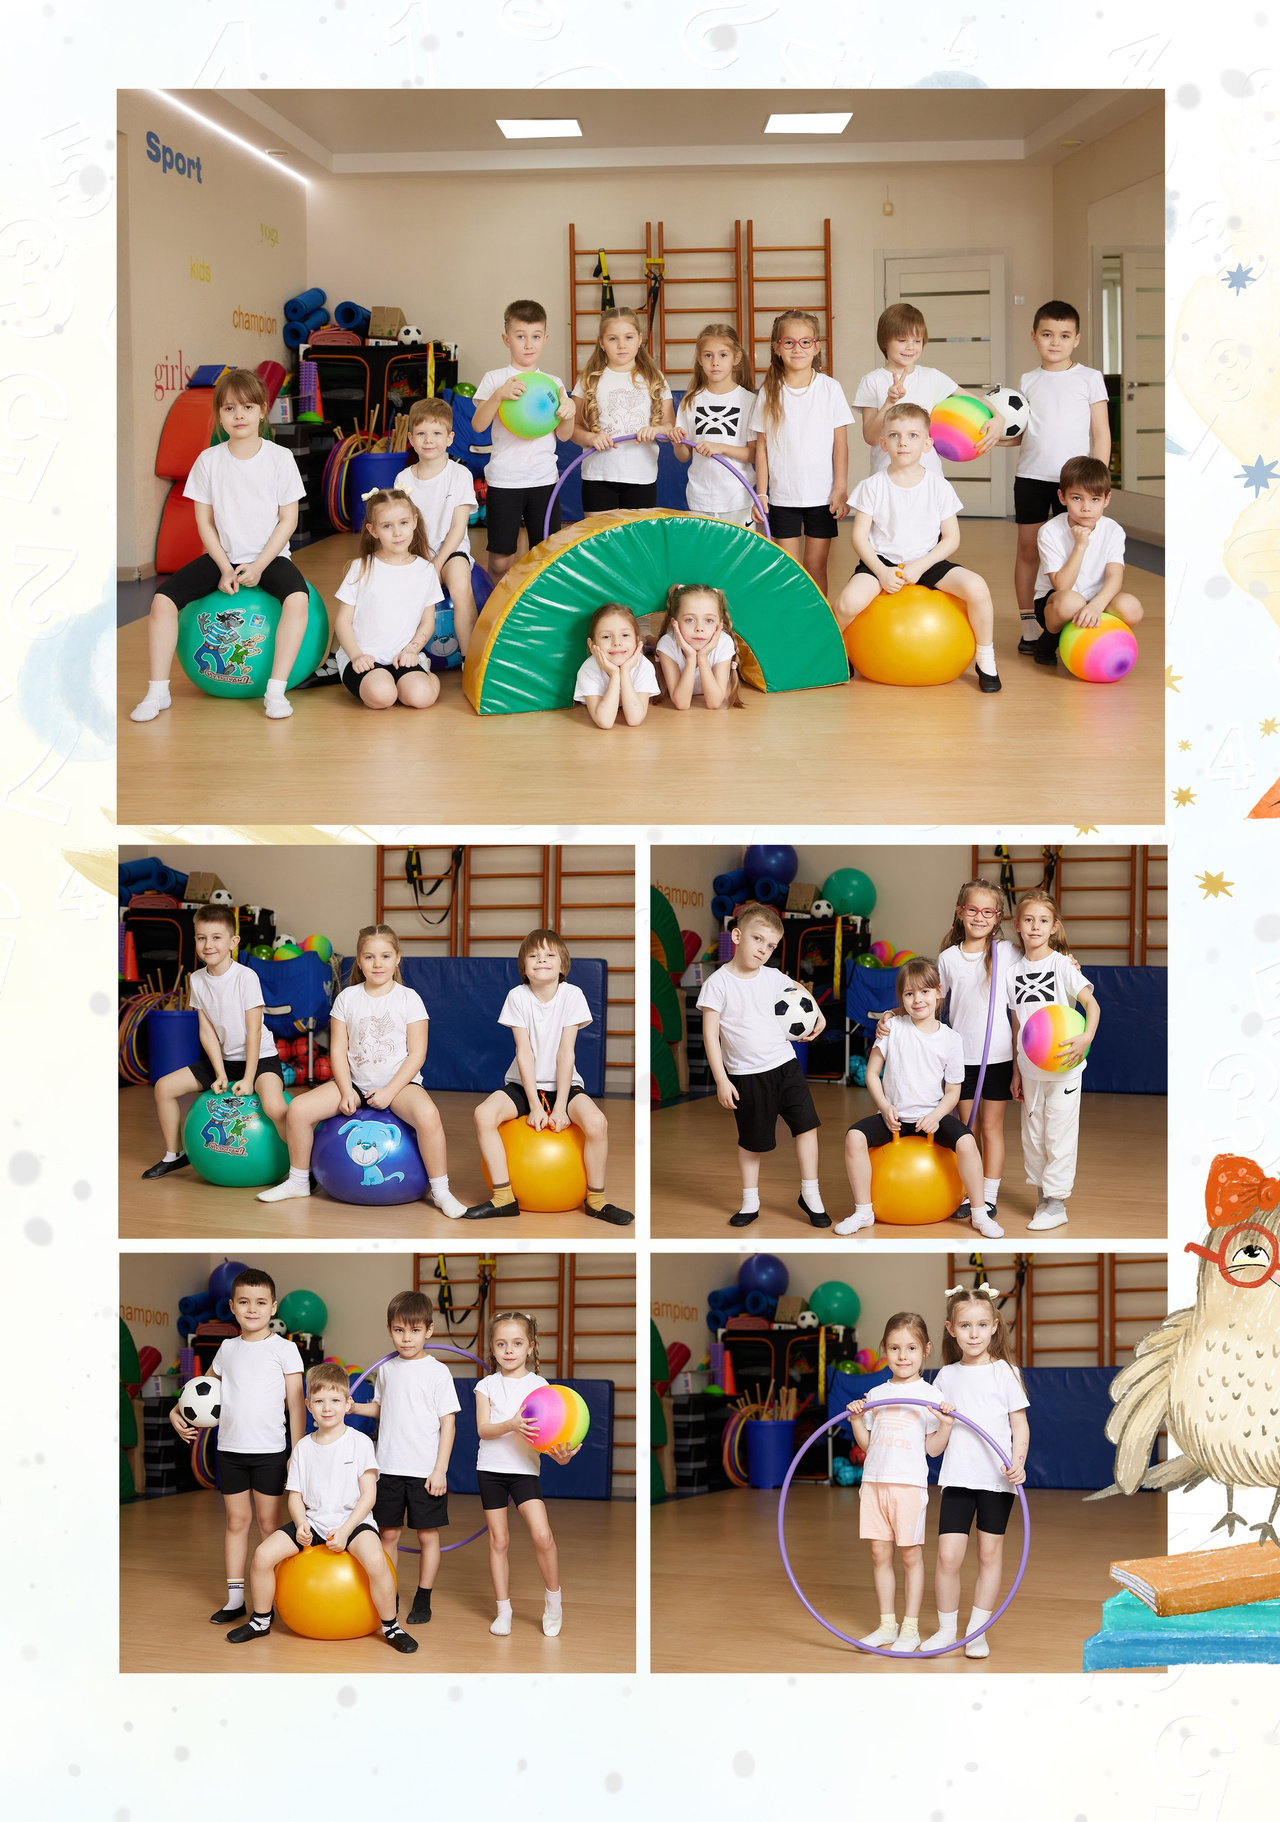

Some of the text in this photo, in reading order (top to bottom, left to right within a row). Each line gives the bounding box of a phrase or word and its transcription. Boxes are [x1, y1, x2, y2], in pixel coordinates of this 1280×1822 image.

[146, 131, 202, 184] Sport
[260, 222, 279, 247] yoga
[190, 255, 211, 283] kids
[232, 305, 278, 337] champion
